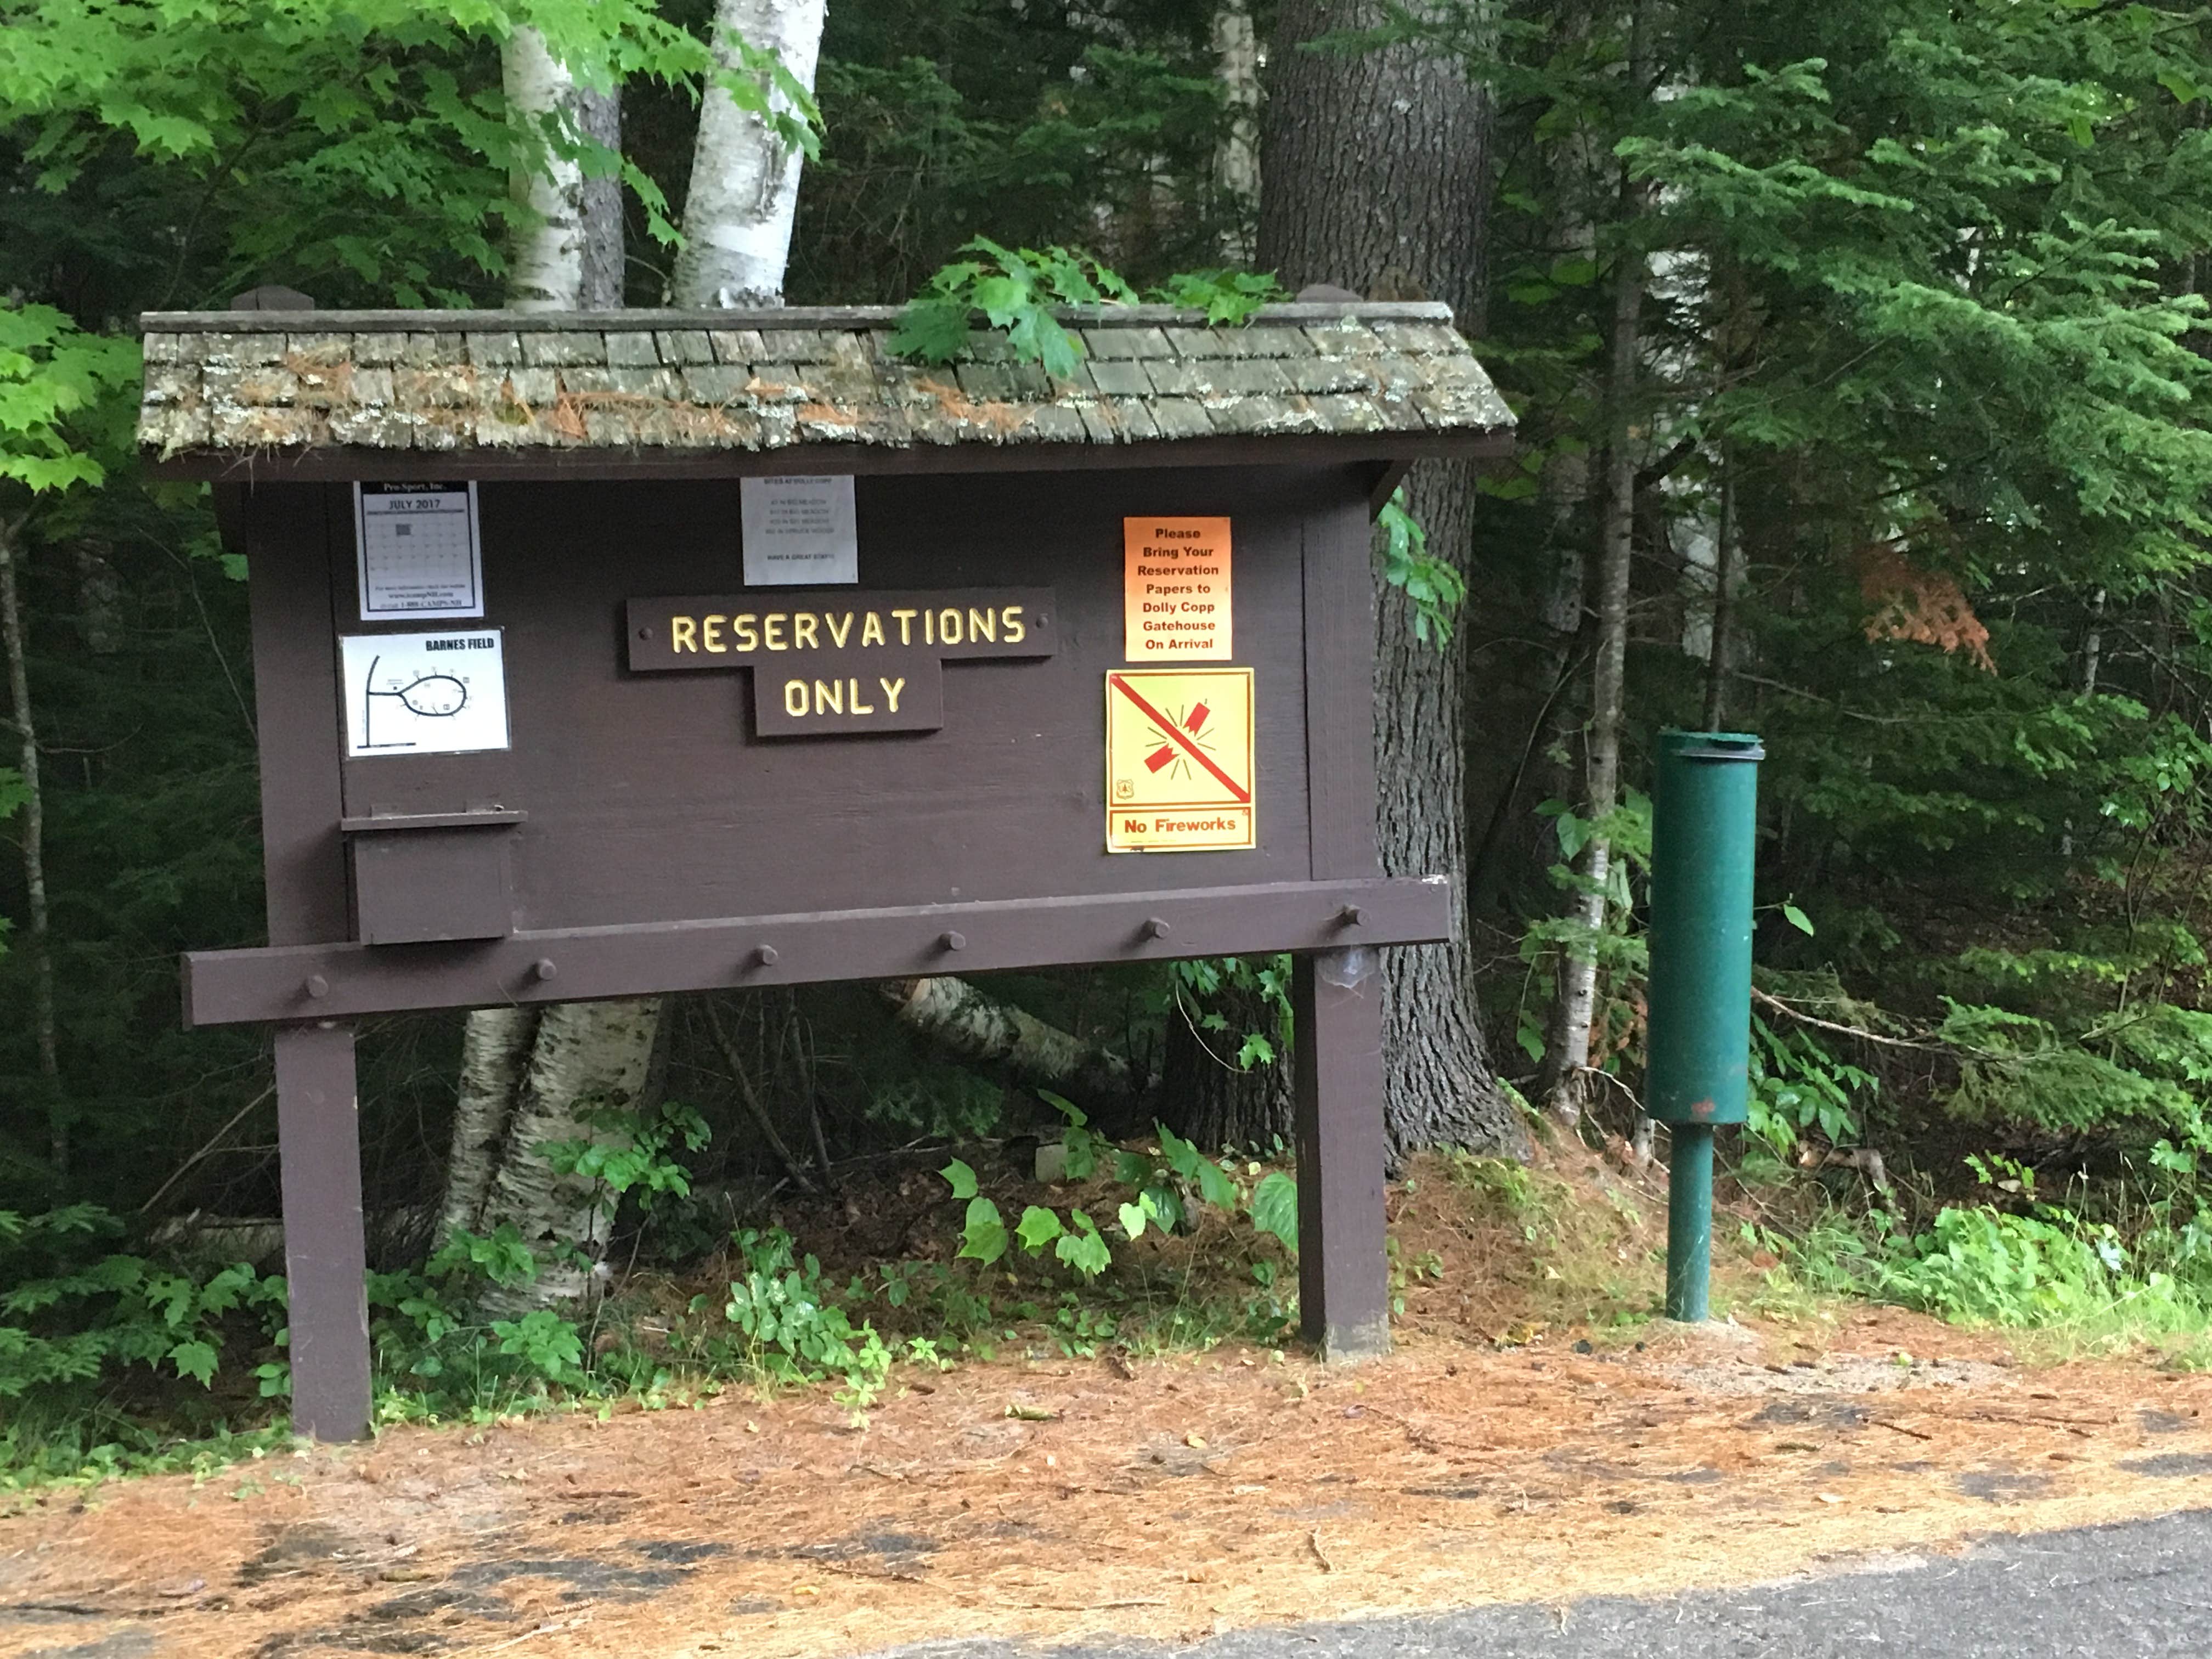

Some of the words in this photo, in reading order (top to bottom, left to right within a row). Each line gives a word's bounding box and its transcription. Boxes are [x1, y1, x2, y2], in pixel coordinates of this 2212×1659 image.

[389, 500, 413, 510] JULY
[416, 499, 441, 509] 2017
[1155, 528, 1201, 539] Please
[1143, 546, 1178, 559] Bring
[1183, 546, 1214, 557] Your
[1137, 565, 1219, 576] Reservation
[1146, 584, 1193, 596] Papers
[1198, 584, 1211, 594] to
[1143, 602, 1177, 614] Dolly
[1181, 602, 1215, 614] Copp
[672, 606, 1026, 653] RESERVATIONS
[1143, 620, 1215, 631] Gatehouse
[425, 638, 466, 651] BARNES
[467, 637, 494, 650] FIELD
[1145, 640, 1164, 650] On
[1168, 639, 1213, 649] Arrival
[785, 676, 905, 716] ONLY
[1125, 820, 1147, 833] No
[1155, 817, 1236, 832] Fireworks
